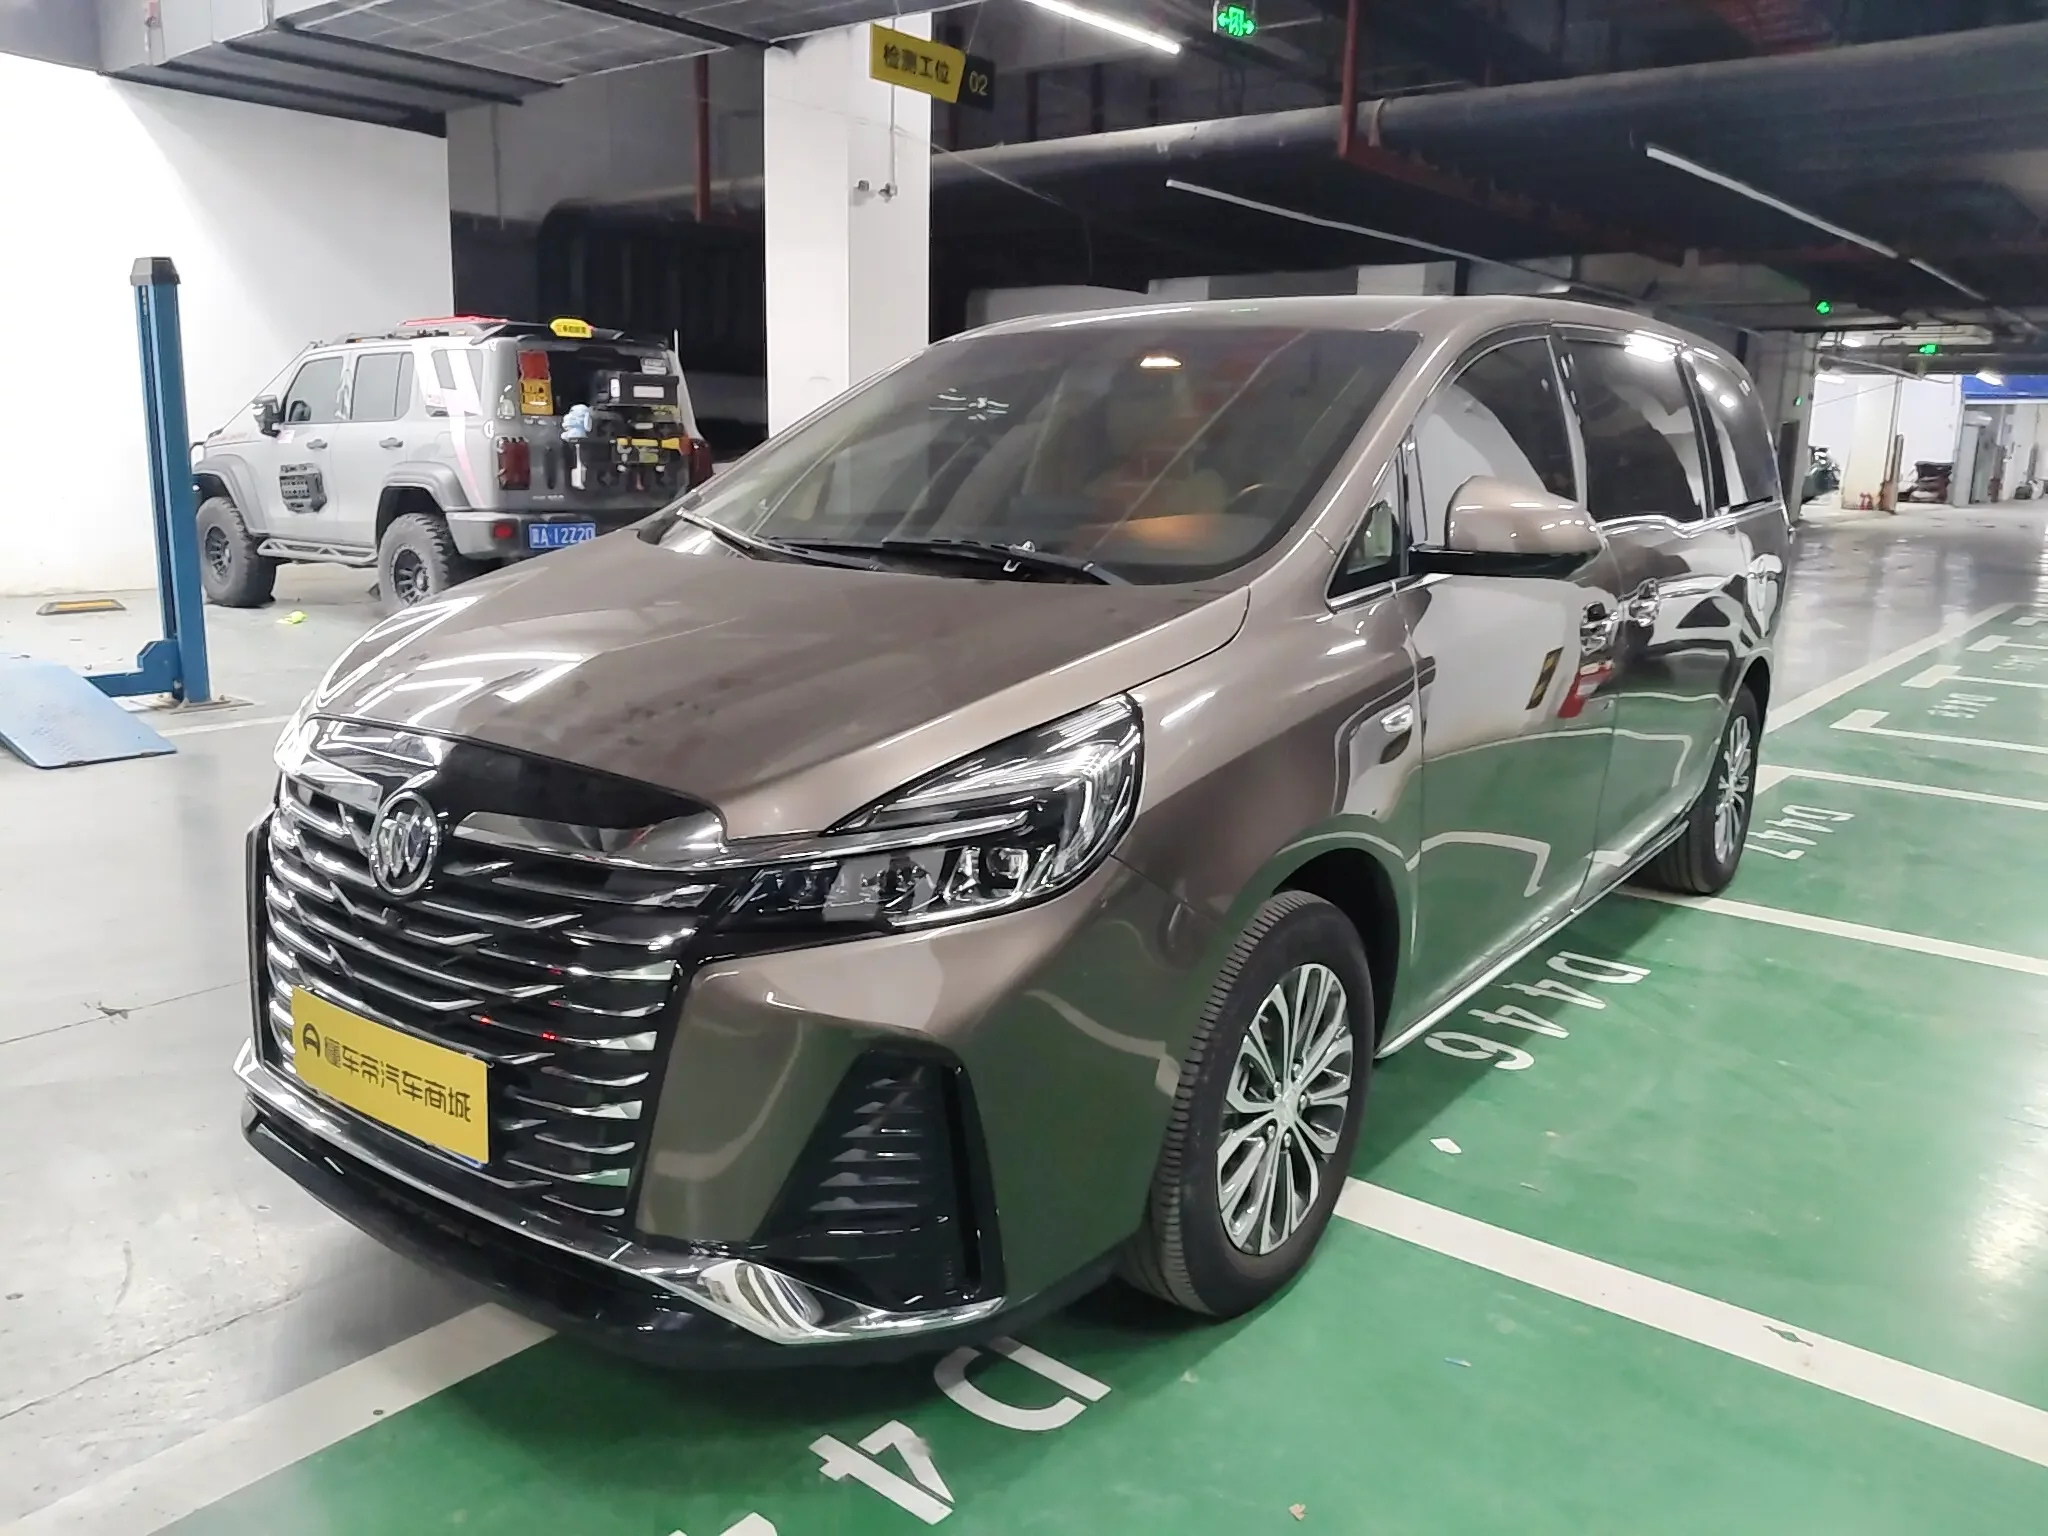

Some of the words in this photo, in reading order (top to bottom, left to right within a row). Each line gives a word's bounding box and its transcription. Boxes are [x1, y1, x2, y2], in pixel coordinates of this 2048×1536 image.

[968, 70, 989, 97] 02
[1424, 950, 1652, 1071] D446
[667, 1336, 1112, 1536] D4
